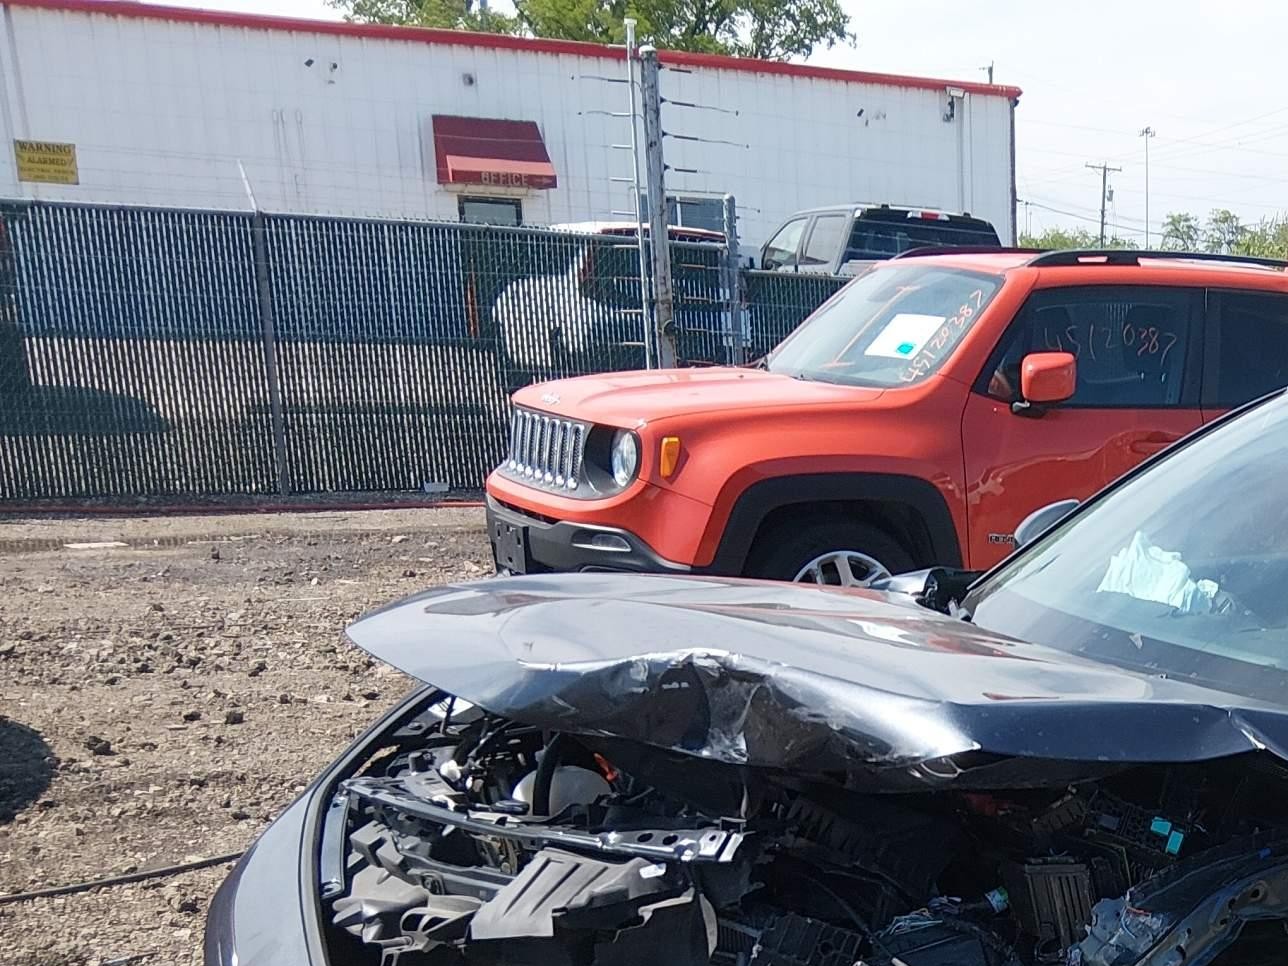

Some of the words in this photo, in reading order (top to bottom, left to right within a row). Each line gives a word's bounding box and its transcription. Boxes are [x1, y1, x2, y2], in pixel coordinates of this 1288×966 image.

[18, 141, 72, 154] WARNING
[26, 156, 67, 167] ALARMED
[480, 171, 529, 187] OFFICE
